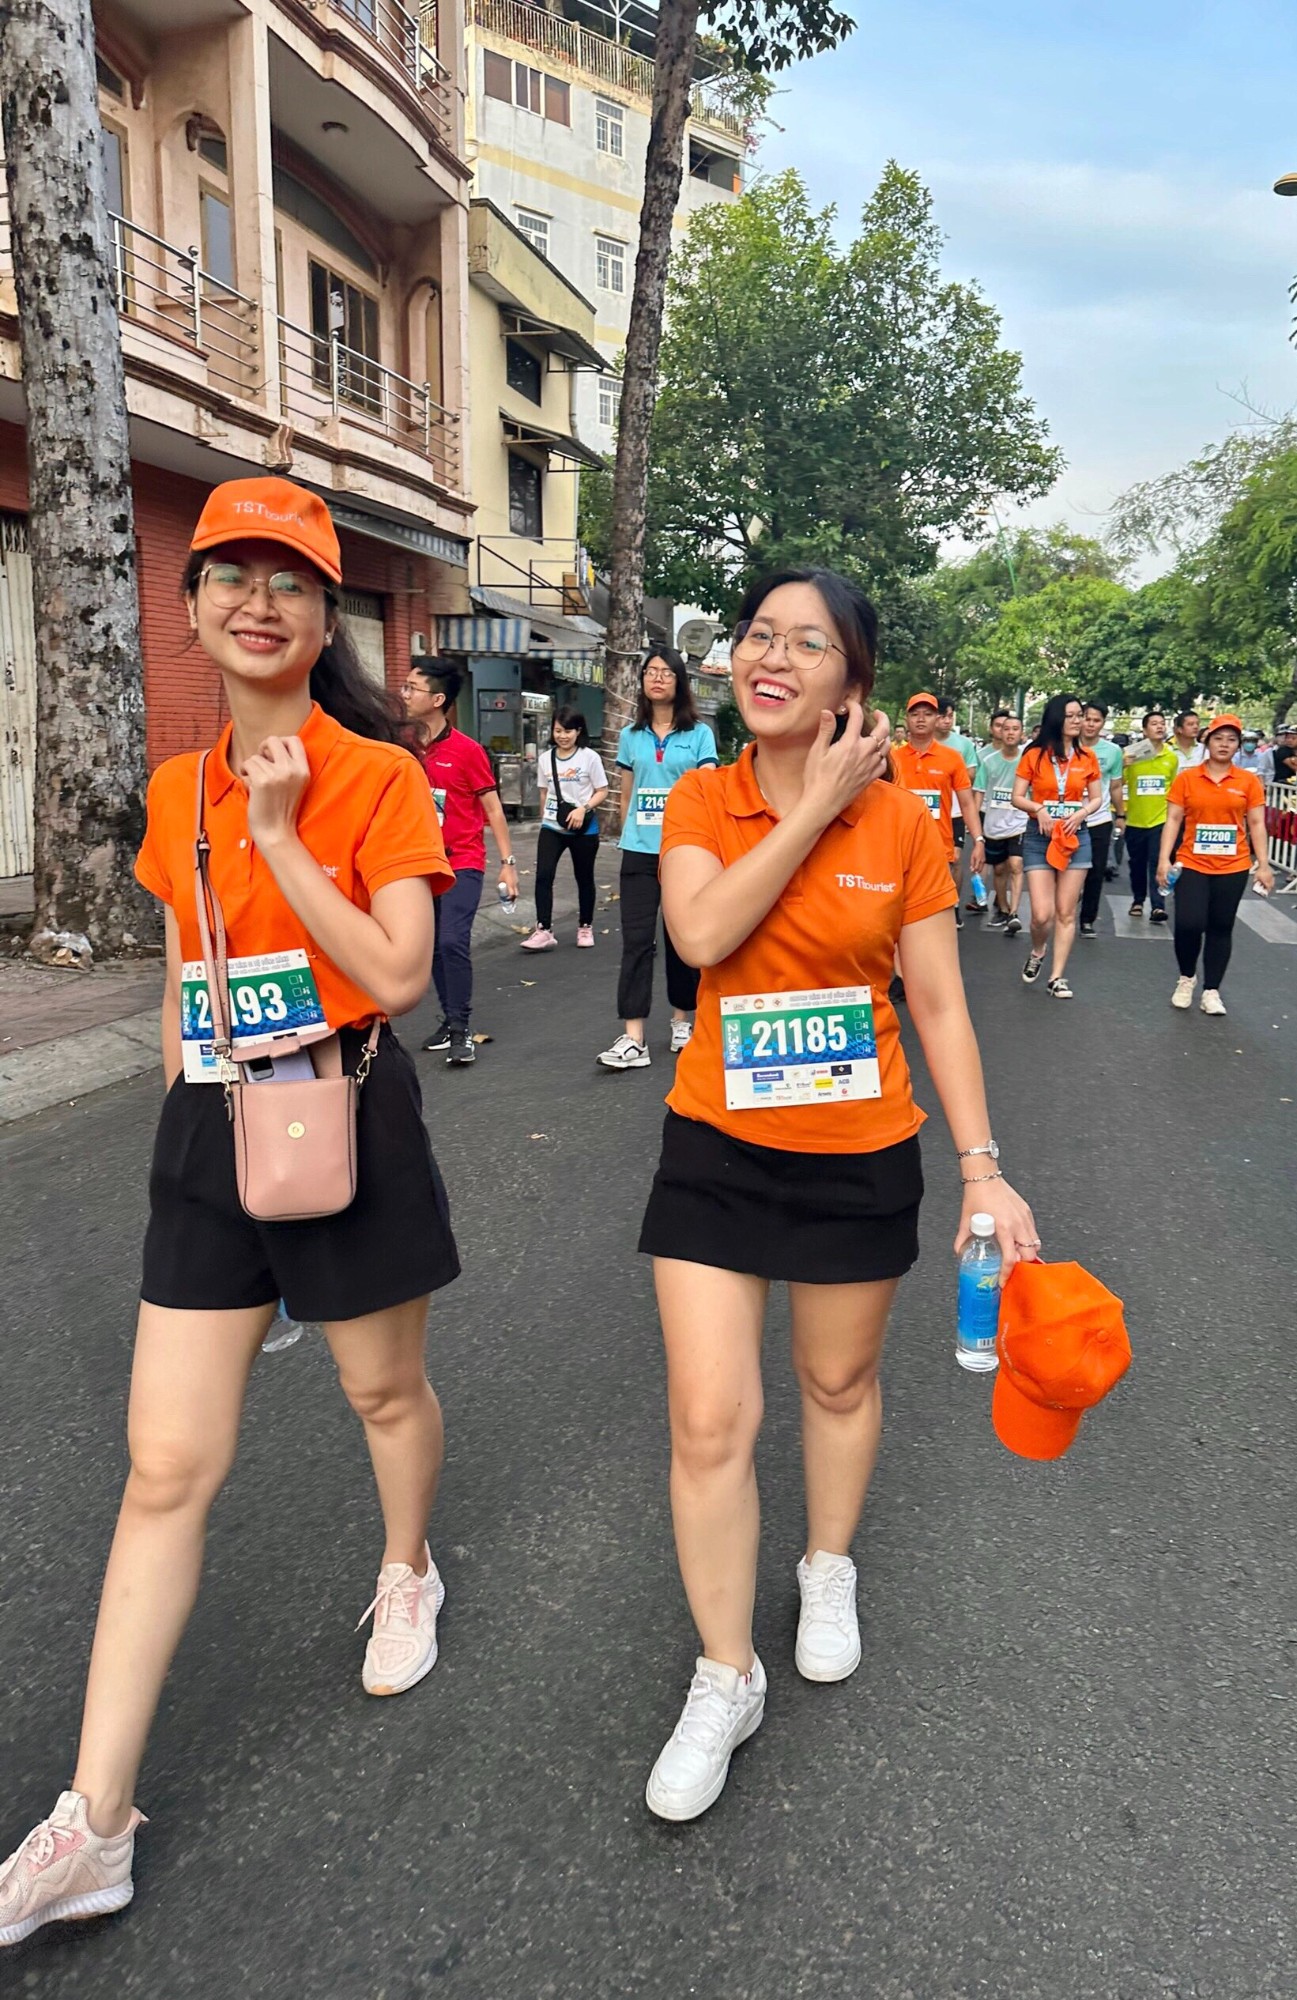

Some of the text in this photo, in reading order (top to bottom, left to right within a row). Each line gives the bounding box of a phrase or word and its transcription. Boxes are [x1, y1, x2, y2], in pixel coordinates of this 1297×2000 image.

[1201, 831, 1231, 842] 21200
[835, 874, 896, 893] TSTtourist
[727, 1023, 739, 1062] 2.3KM
[751, 1014, 848, 1057] 21185
